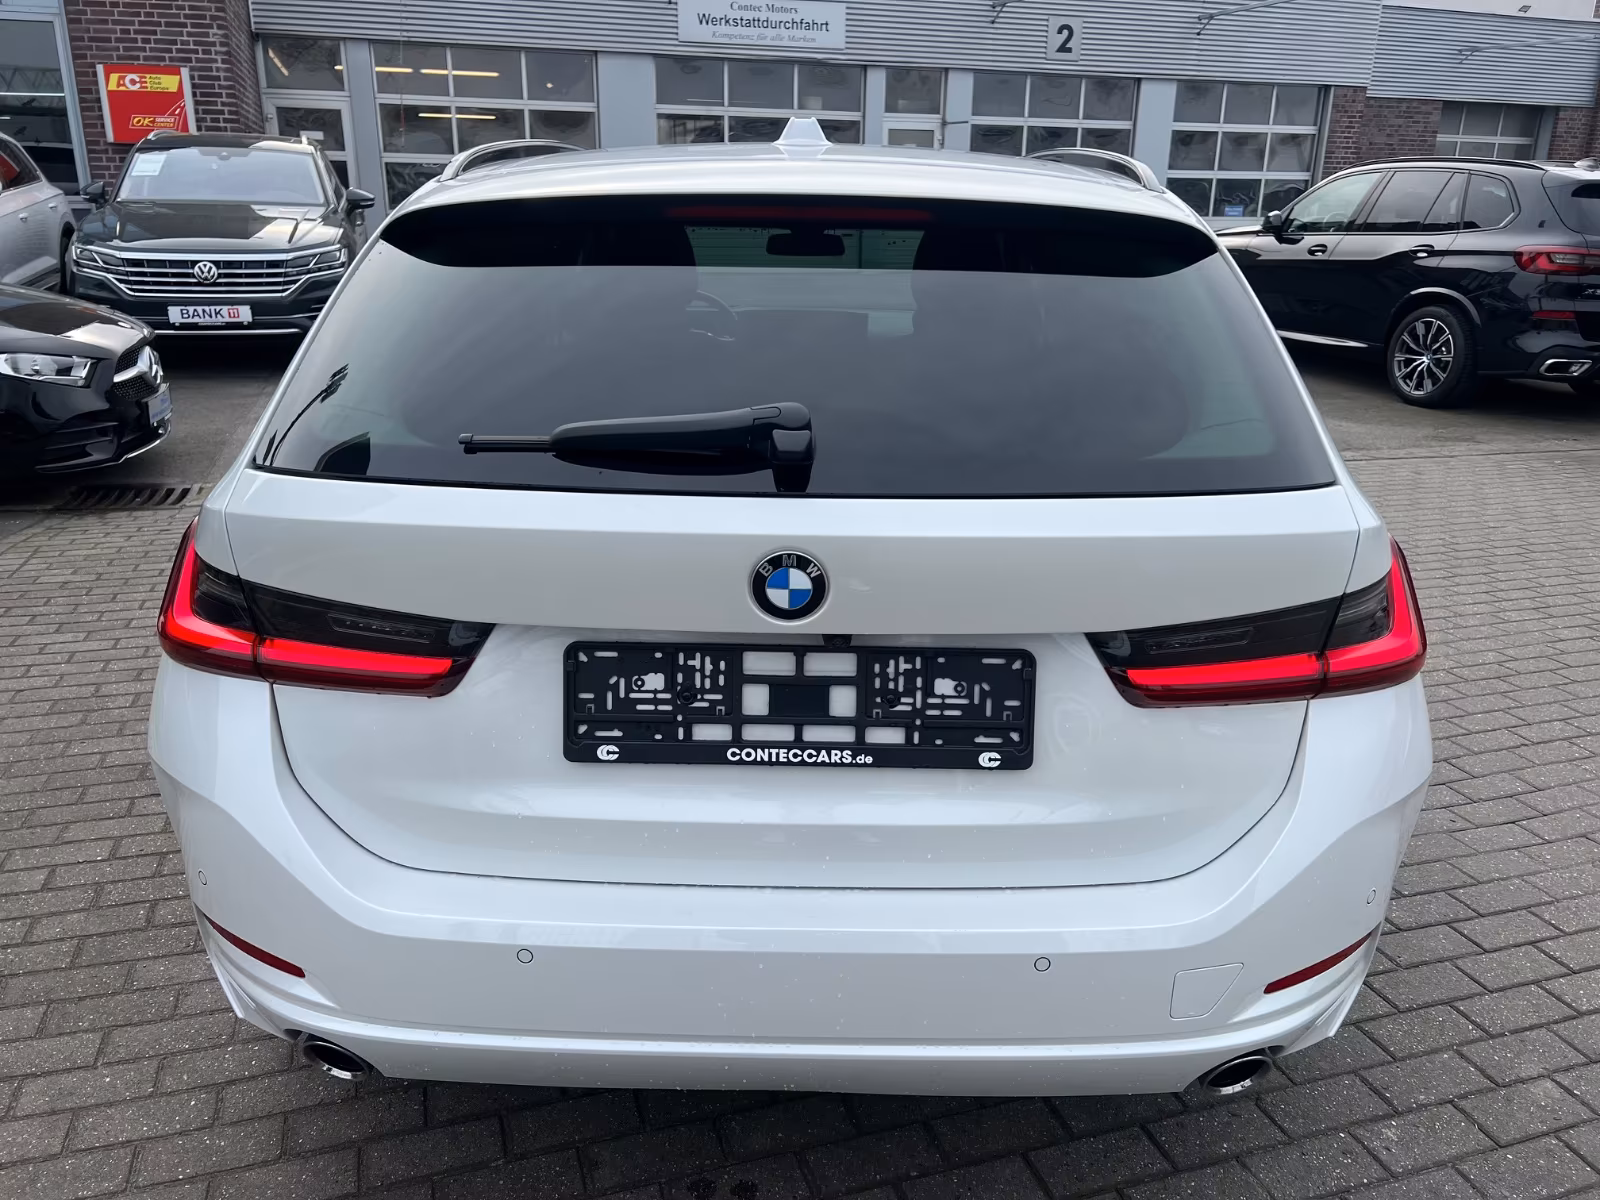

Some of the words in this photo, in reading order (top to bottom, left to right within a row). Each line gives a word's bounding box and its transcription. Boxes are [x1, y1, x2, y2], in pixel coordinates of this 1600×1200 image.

[730, 1, 763, 13] Contec
[764, 3, 799, 15] Motors
[697, 13, 830, 33] Werkstattdurchfahrt
[711, 31, 755, 41] Kompetenz
[755, 33, 768, 42] für
[769, 33, 786, 43] alle
[787, 34, 817, 44] Marken
[1055, 23, 1074, 54] 2
[133, 117, 154, 127] OK
[180, 308, 225, 320] BANK
[759, 554, 821, 578] BMW
[726, 747, 874, 764] CONTECCARS.de
